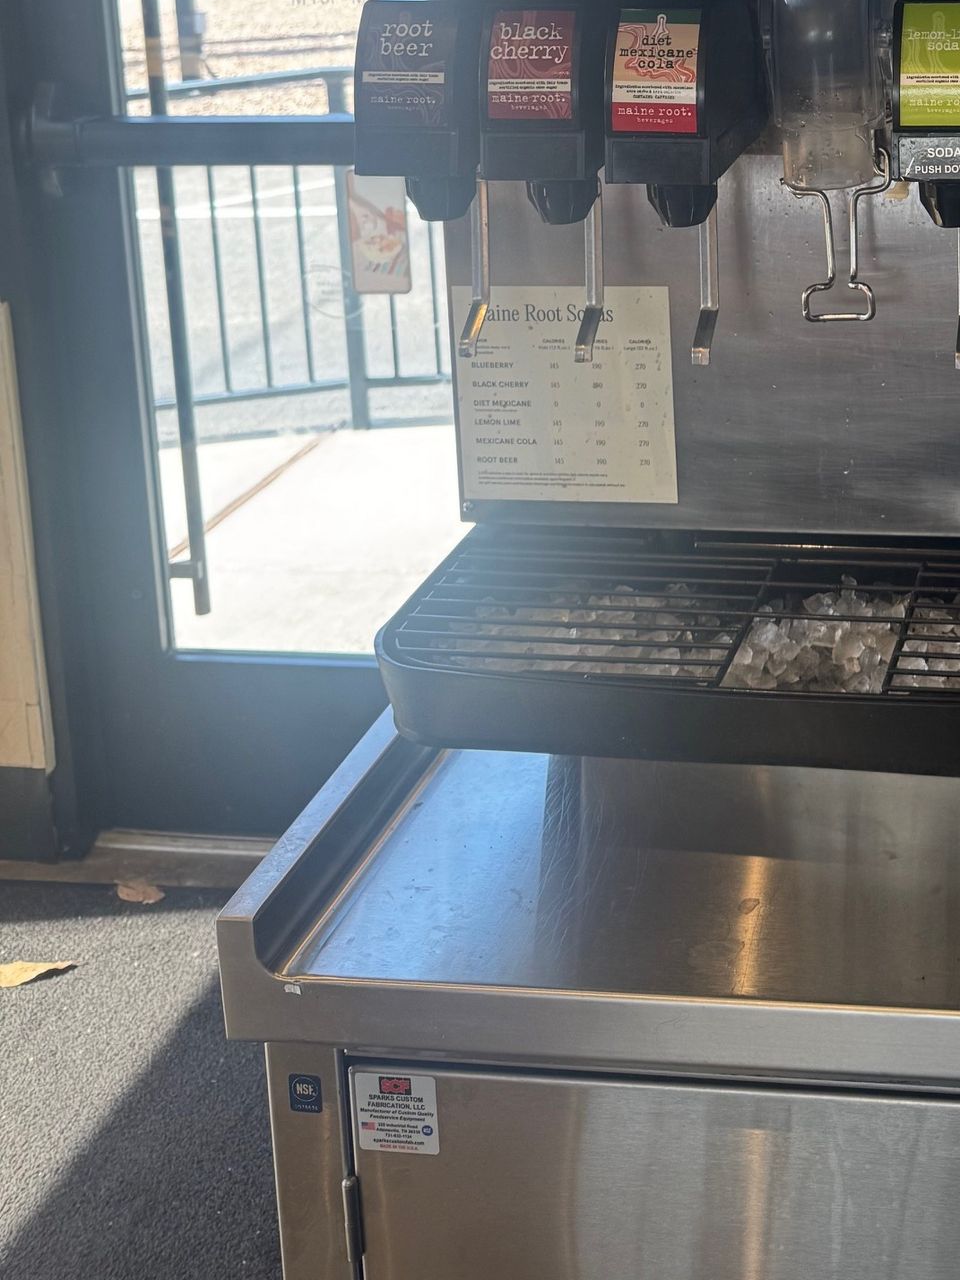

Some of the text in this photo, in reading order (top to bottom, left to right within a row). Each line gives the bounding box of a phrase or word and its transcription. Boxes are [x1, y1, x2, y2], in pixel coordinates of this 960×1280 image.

[381, 20, 433, 37] root
[500, 23, 563, 40] black
[641, 35, 672, 46] diet
[927, 40, 960, 51] soda
[380, 38, 433, 56] beer
[490, 42, 569, 63] cherry
[619, 47, 694, 58] mexicane
[638, 59, 674, 69] cola
[370, 96, 403, 104] maine
[492, 93, 566, 103] maine root.
[909, 97, 943, 106] maine
[618, 106, 692, 116] maine root.
[915, 165, 942, 174] PUSH
[525, 304, 563, 322] Root
[296, 1083, 314, 1095] NSF
